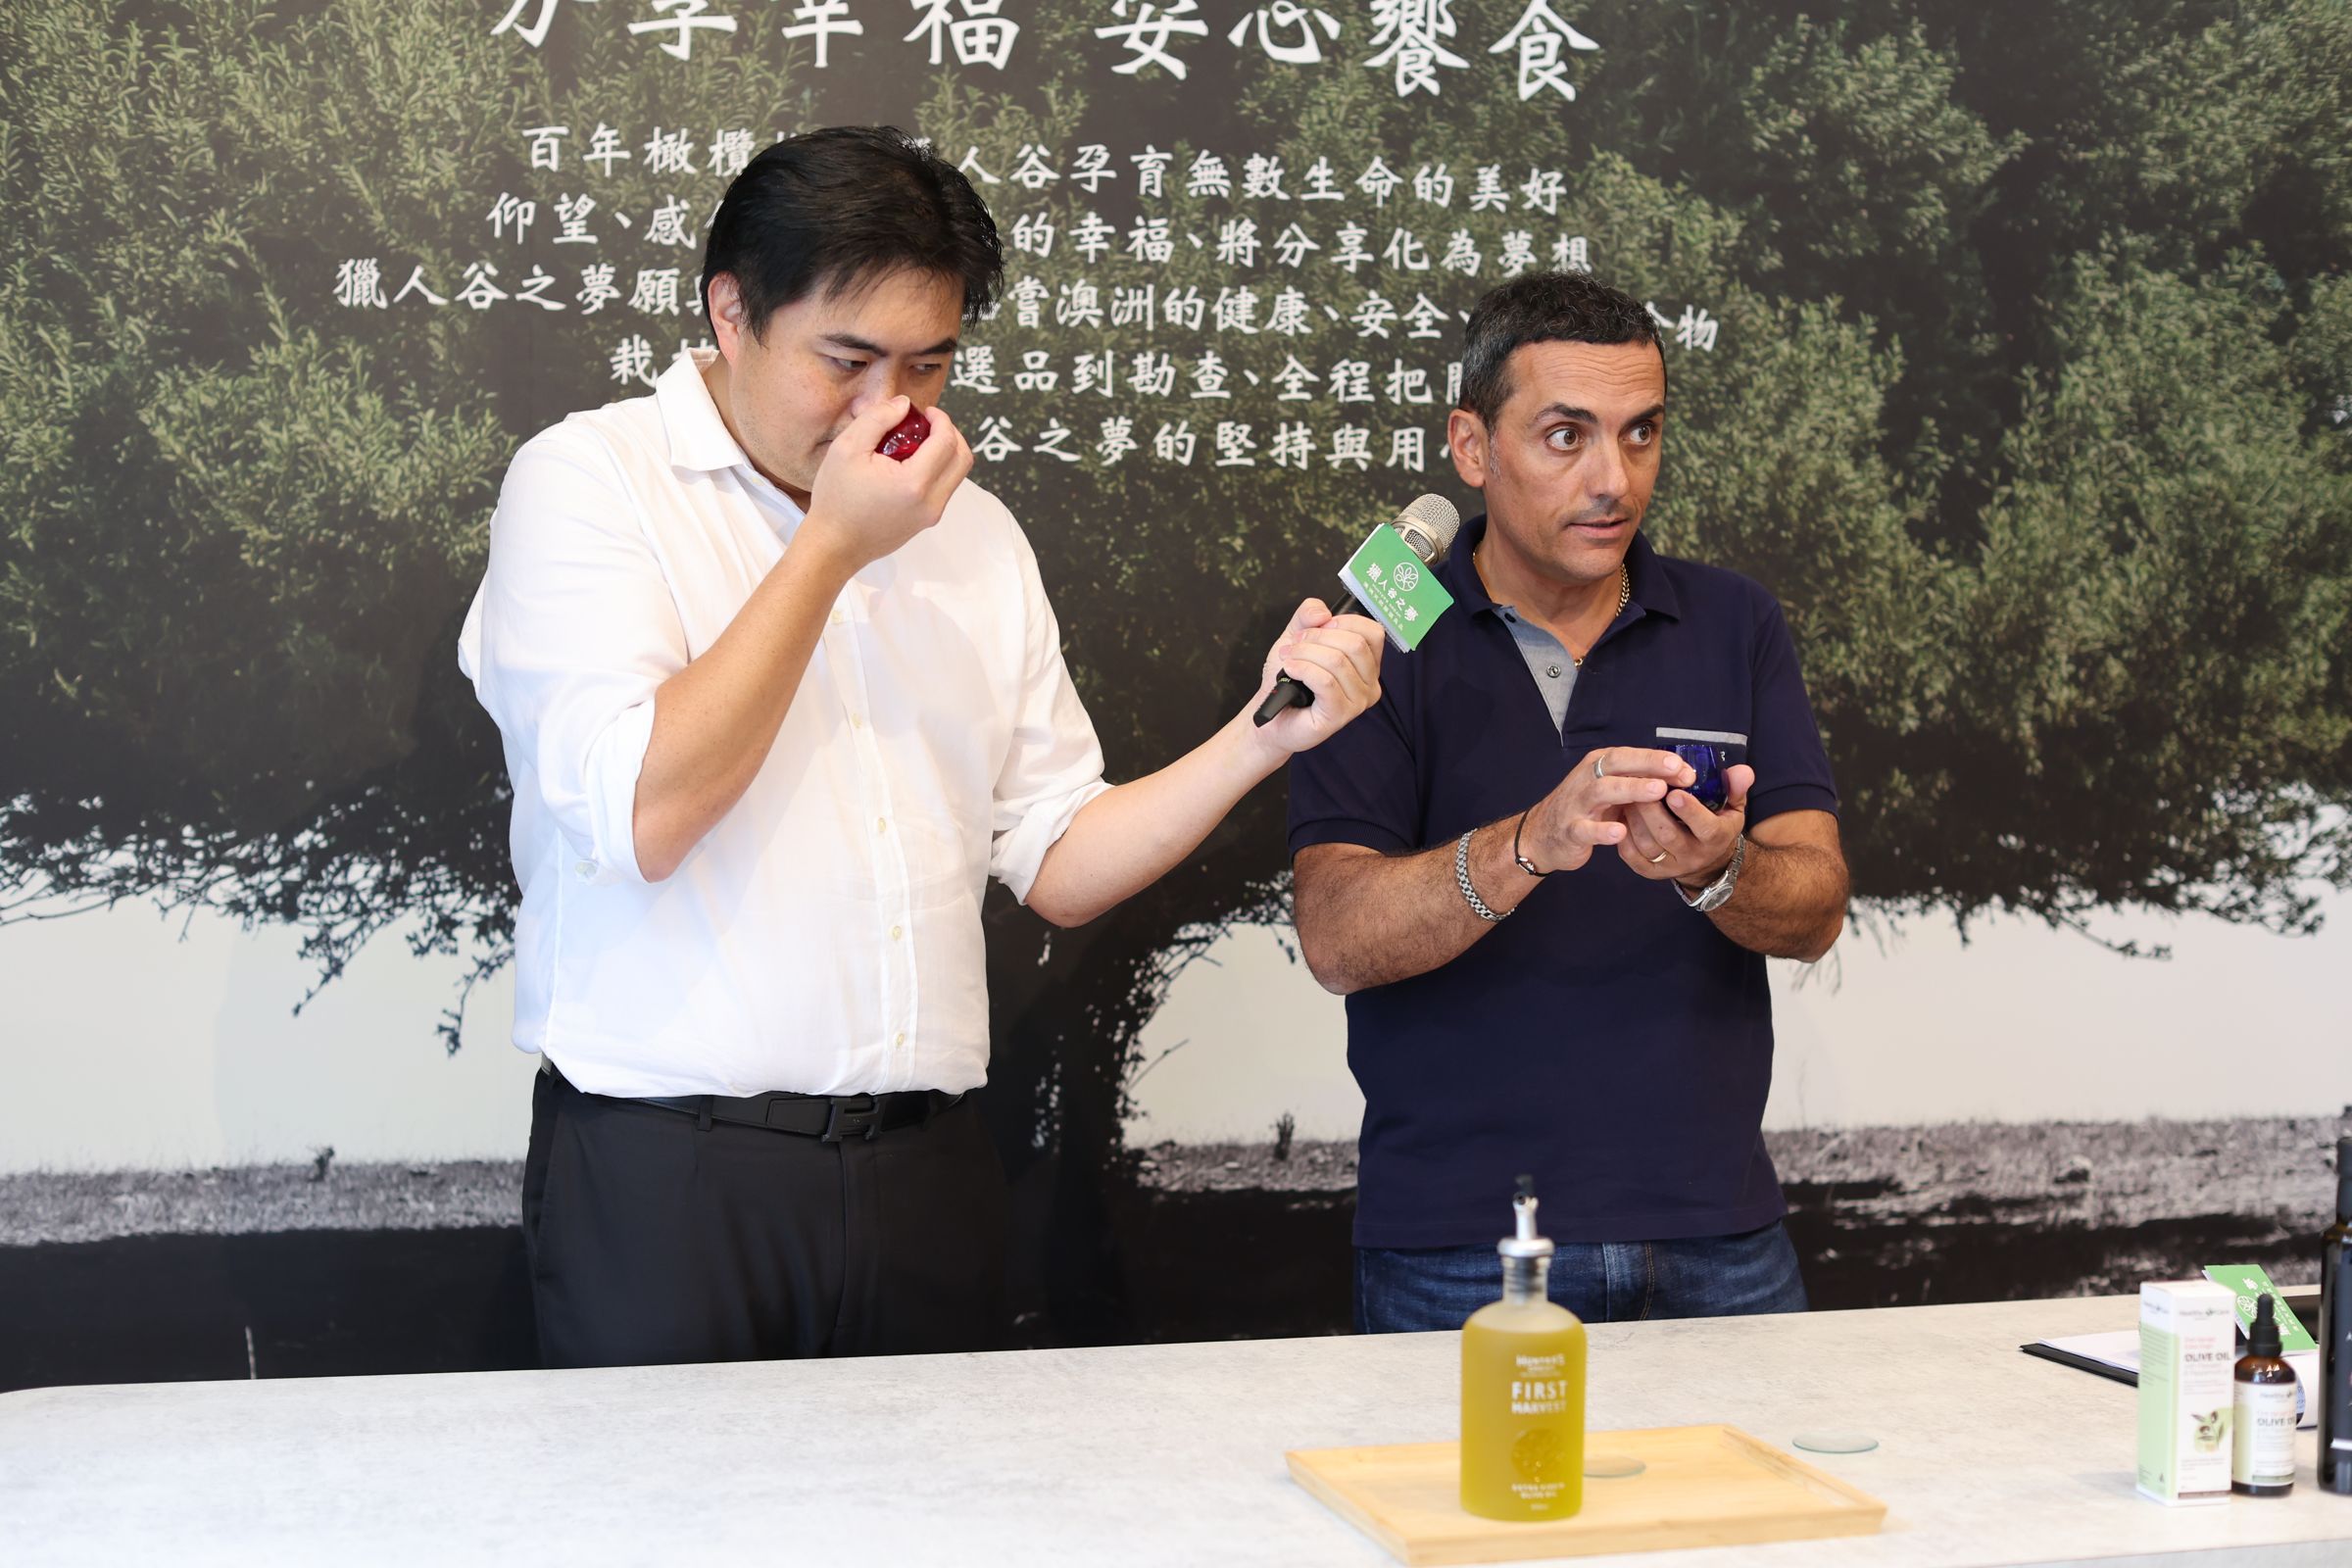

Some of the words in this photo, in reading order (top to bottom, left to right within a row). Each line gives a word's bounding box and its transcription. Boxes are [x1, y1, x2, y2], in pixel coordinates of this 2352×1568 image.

[1094, 0, 1600, 102] 安心饗食
[521, 122, 796, 177] 百年橄欖
[902, 137, 1568, 216] 人谷孕育無數生命的美好
[486, 192, 723, 251] 仰望、感
[332, 257, 704, 317] 獵人谷之夢願
[963, 275, 1469, 339] 嘗澳洲的健康、安全、
[972, 416, 1450, 473] 谷之夢的堅持與用
[2184, 1352, 2213, 1362] OLIVE
[2215, 1351, 2230, 1361] OIL
[1511, 1381, 1568, 1400] FIRST
